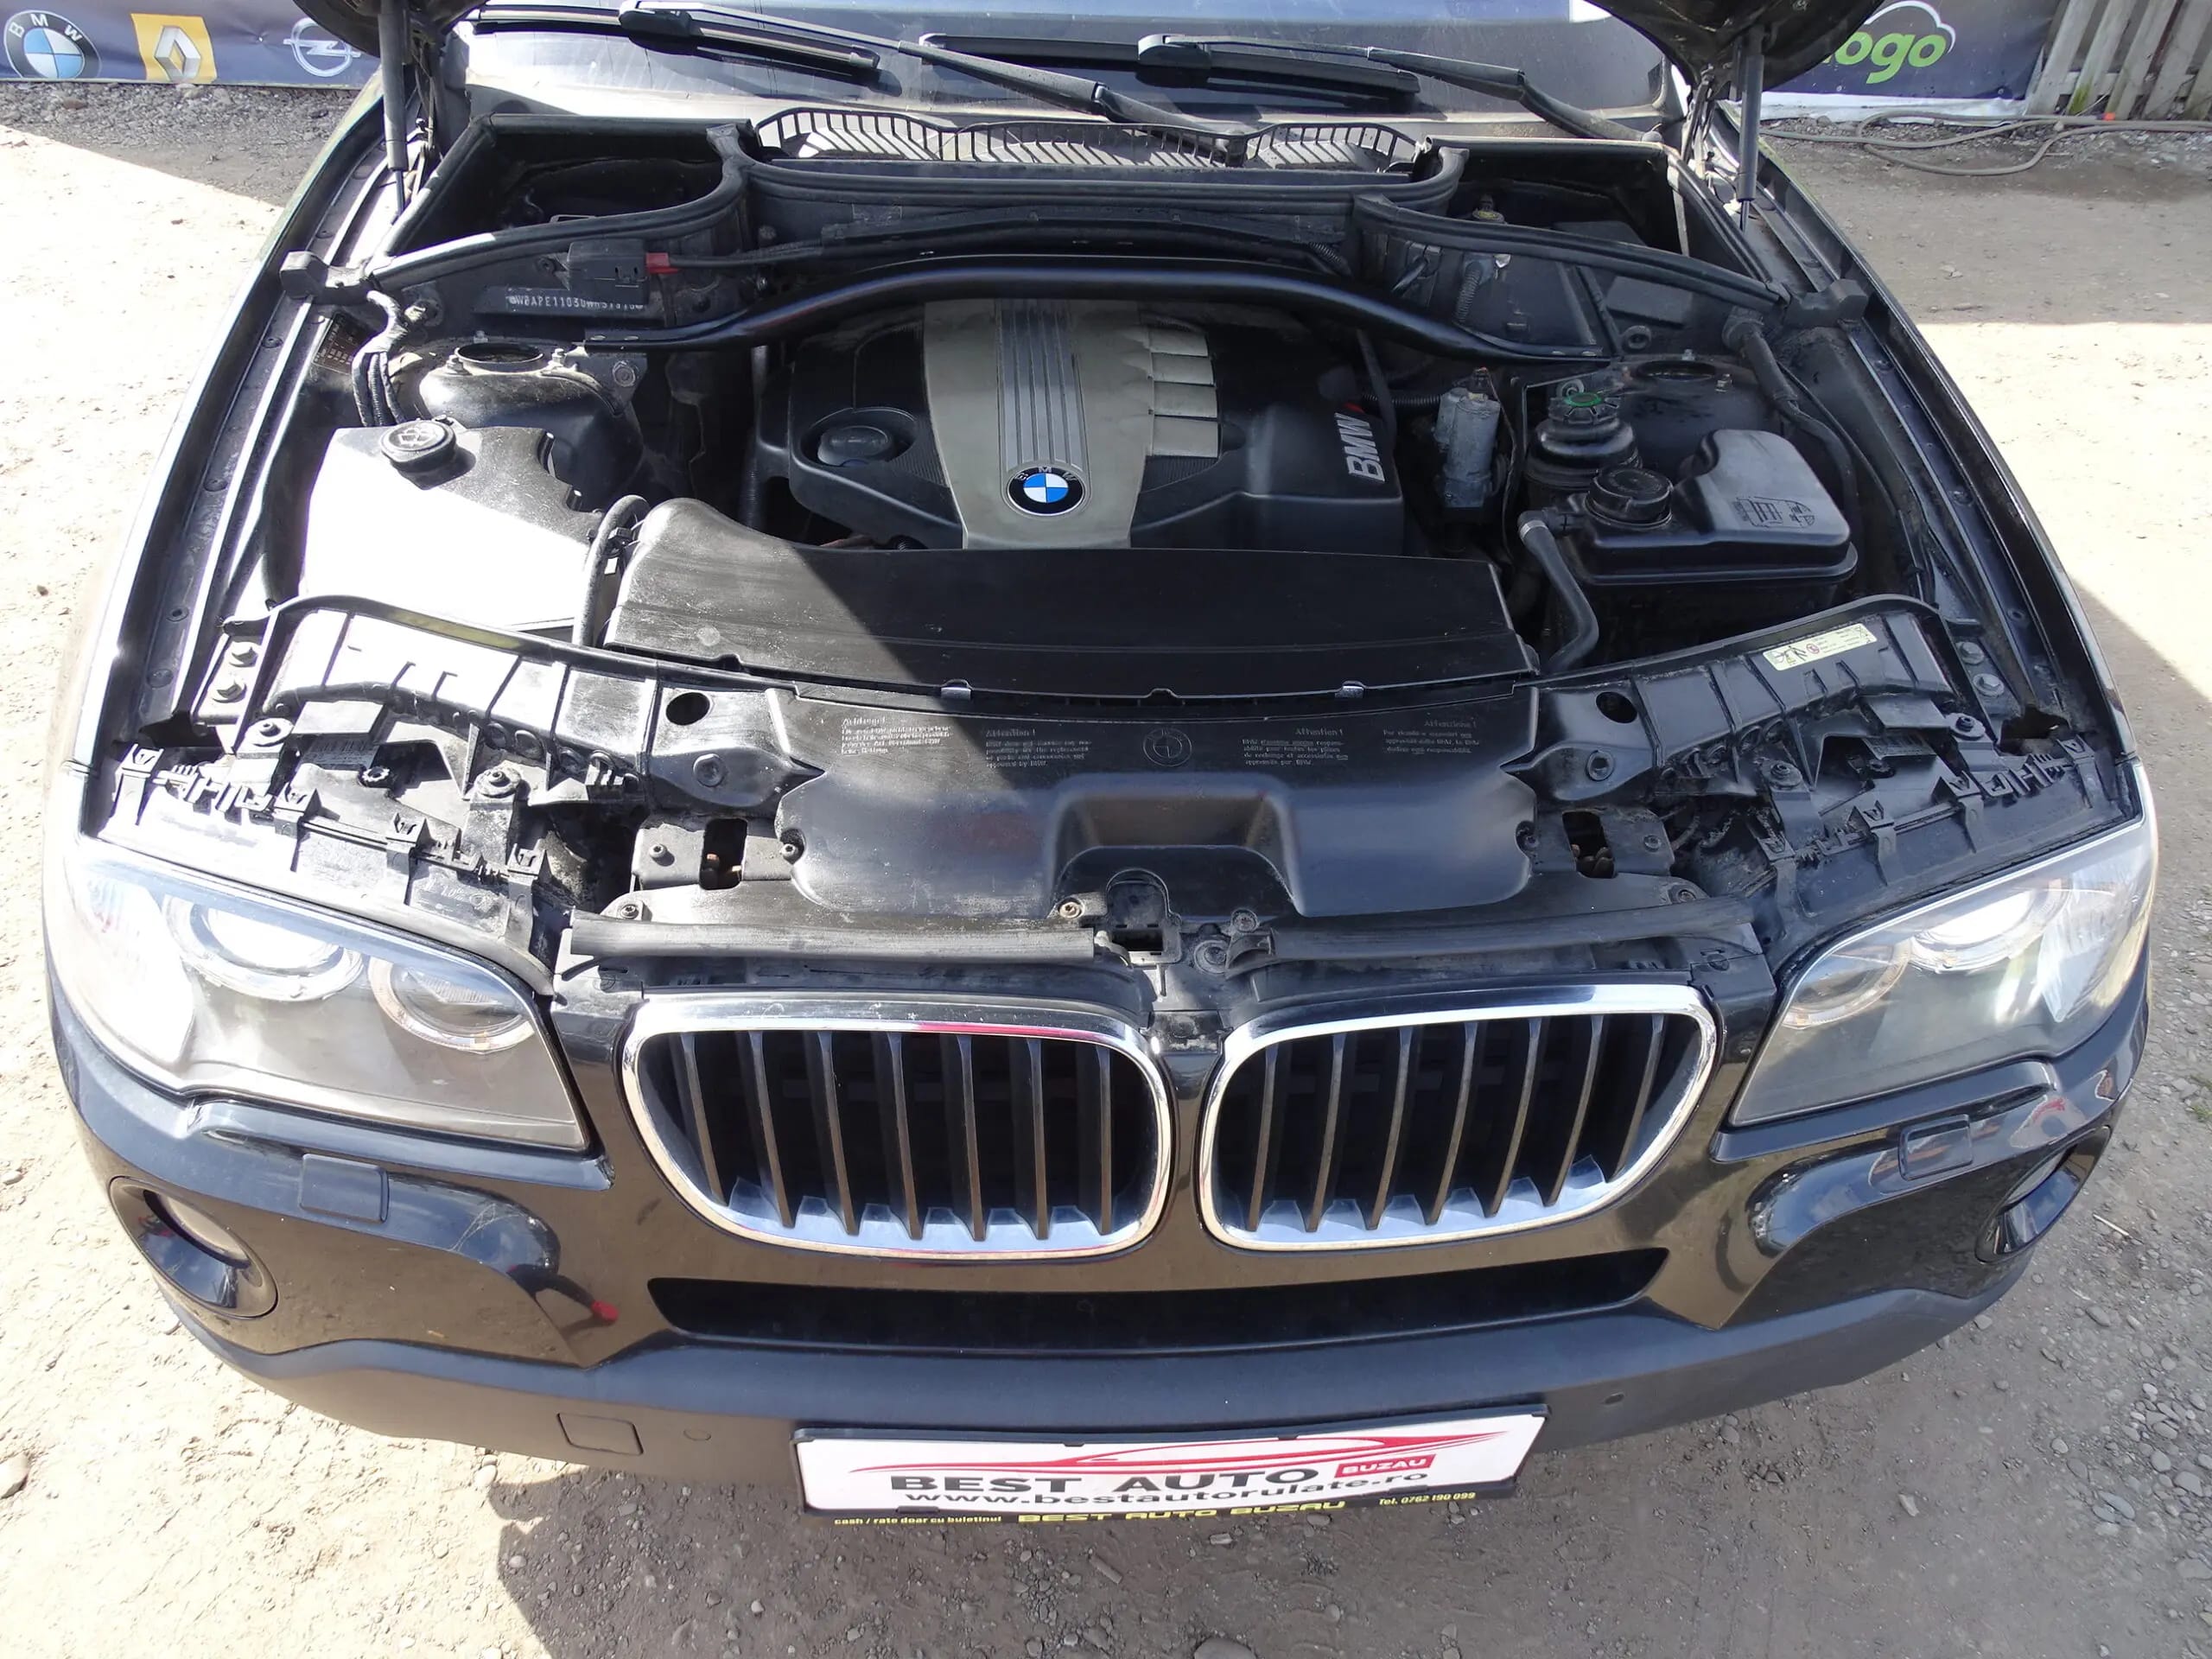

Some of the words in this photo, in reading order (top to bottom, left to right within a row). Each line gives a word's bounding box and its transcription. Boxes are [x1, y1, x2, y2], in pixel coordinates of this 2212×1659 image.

[8, 13, 84, 42] BMW
[1822, 31, 1947, 85] ogo
[1334, 412, 1385, 482] BMW
[891, 1475, 1083, 1493] BEST
[1112, 1468, 1319, 1492] AUTO
[1342, 1458, 1427, 1474] BUZAU
[906, 1471, 1429, 1504] www.bestautorulate.ro
[1019, 1513, 1113, 1522] BEST
[1126, 1509, 1217, 1519] AUTO
[1230, 1500, 1346, 1515] BUZAU
